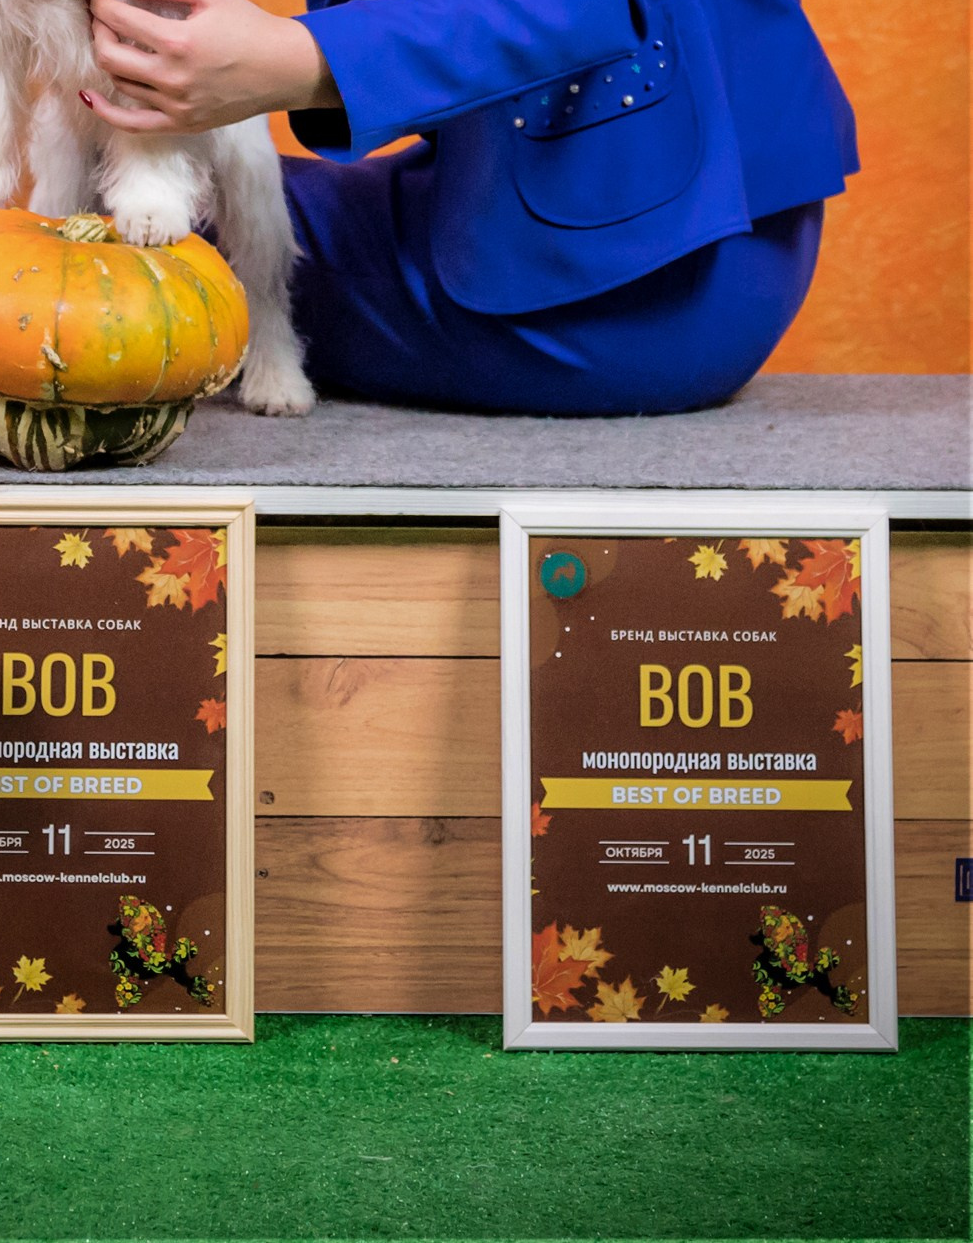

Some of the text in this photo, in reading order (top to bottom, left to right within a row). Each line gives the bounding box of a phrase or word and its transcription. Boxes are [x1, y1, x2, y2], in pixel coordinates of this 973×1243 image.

[22, 618, 93, 630] ВЫСТАВКА
[96, 619, 142, 631] СОБАК
[610, 629, 777, 643] БРЕНД ВЫСТАВКА СОБАК
[3, 653, 116, 716] BOB
[640, 664, 753, 727] BOB
[89, 741, 179, 761] выставка
[582, 751, 817, 773] монопородная выставка
[33, 775, 64, 793] OF
[69, 776, 143, 795] BREED
[611, 785, 782, 805] BEST OF BREED
[42, 823, 71, 855] 11
[104, 838, 135, 849] 2025
[605, 834, 775, 866] ОКТЯБРЯ 11 2025
[607, 882, 787, 894] www.moscow-kennelclub.ru
